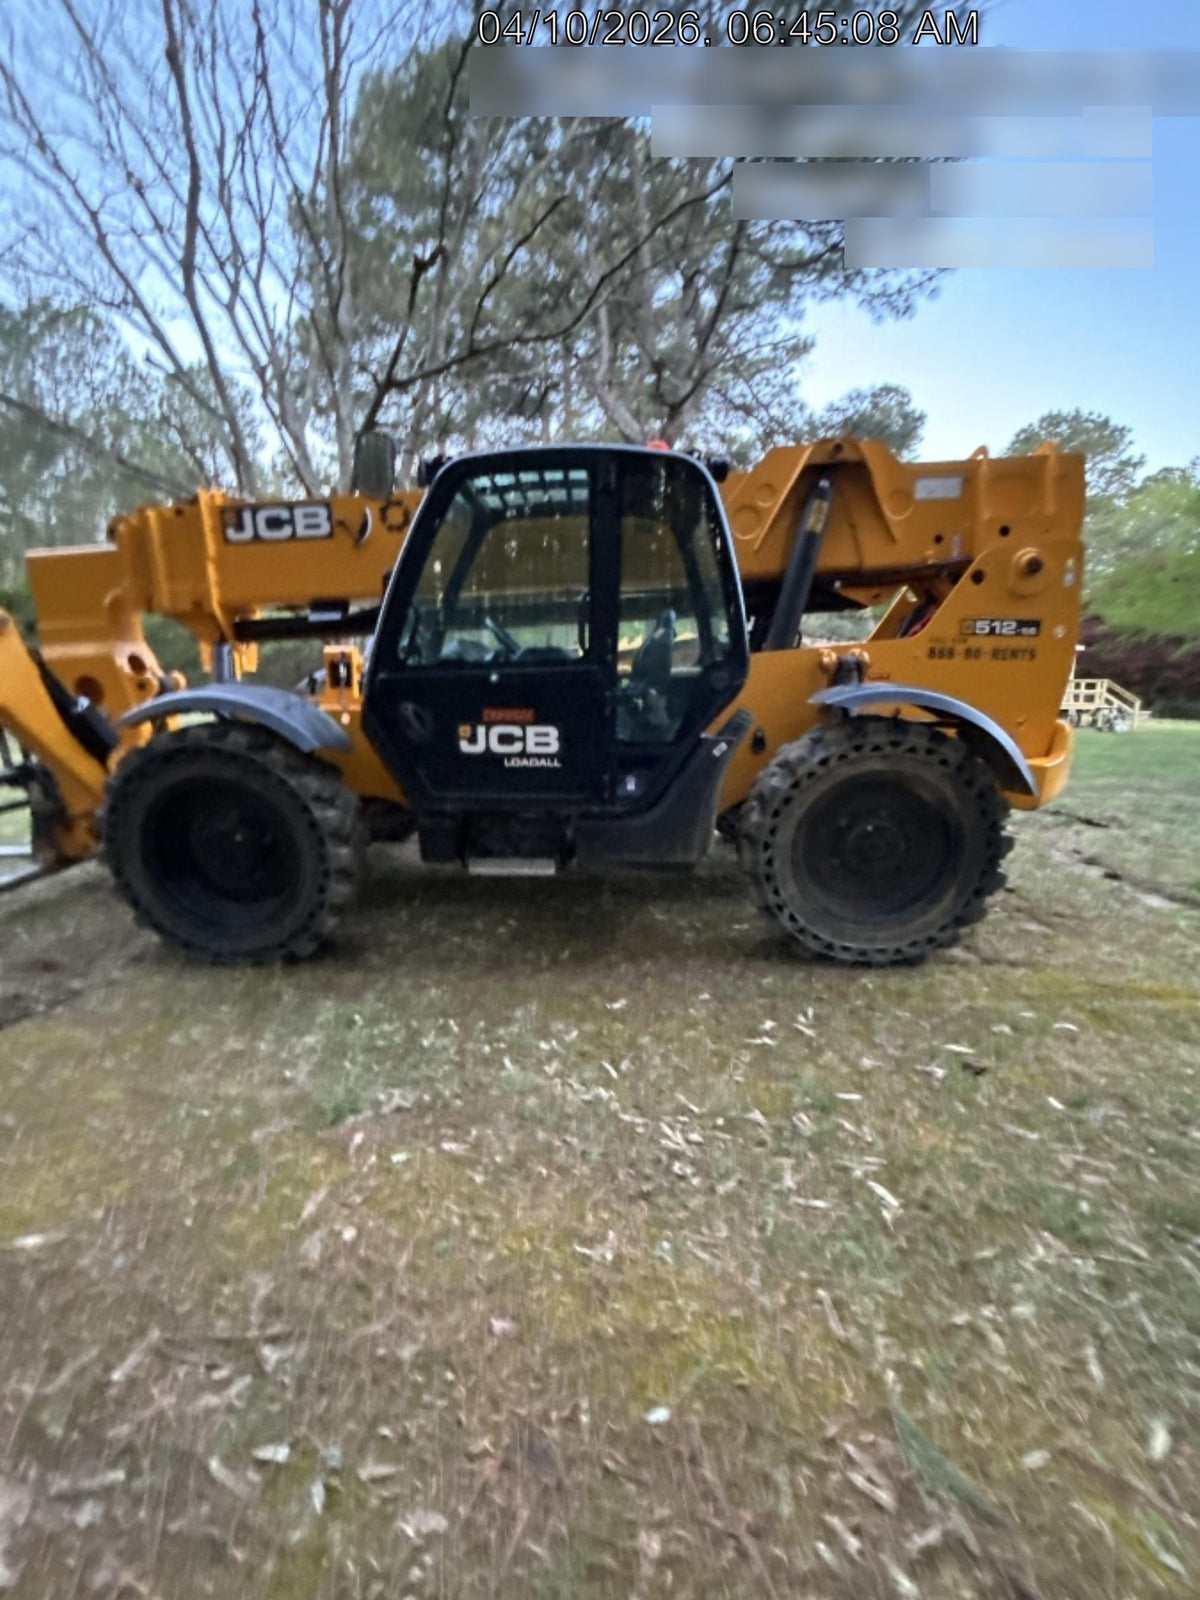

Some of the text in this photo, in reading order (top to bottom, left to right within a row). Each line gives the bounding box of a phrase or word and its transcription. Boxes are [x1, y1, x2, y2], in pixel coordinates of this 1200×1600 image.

[224, 504, 332, 542] JCB
[458, 724, 560, 754] JCB
[503, 757, 562, 768] LOADALL
